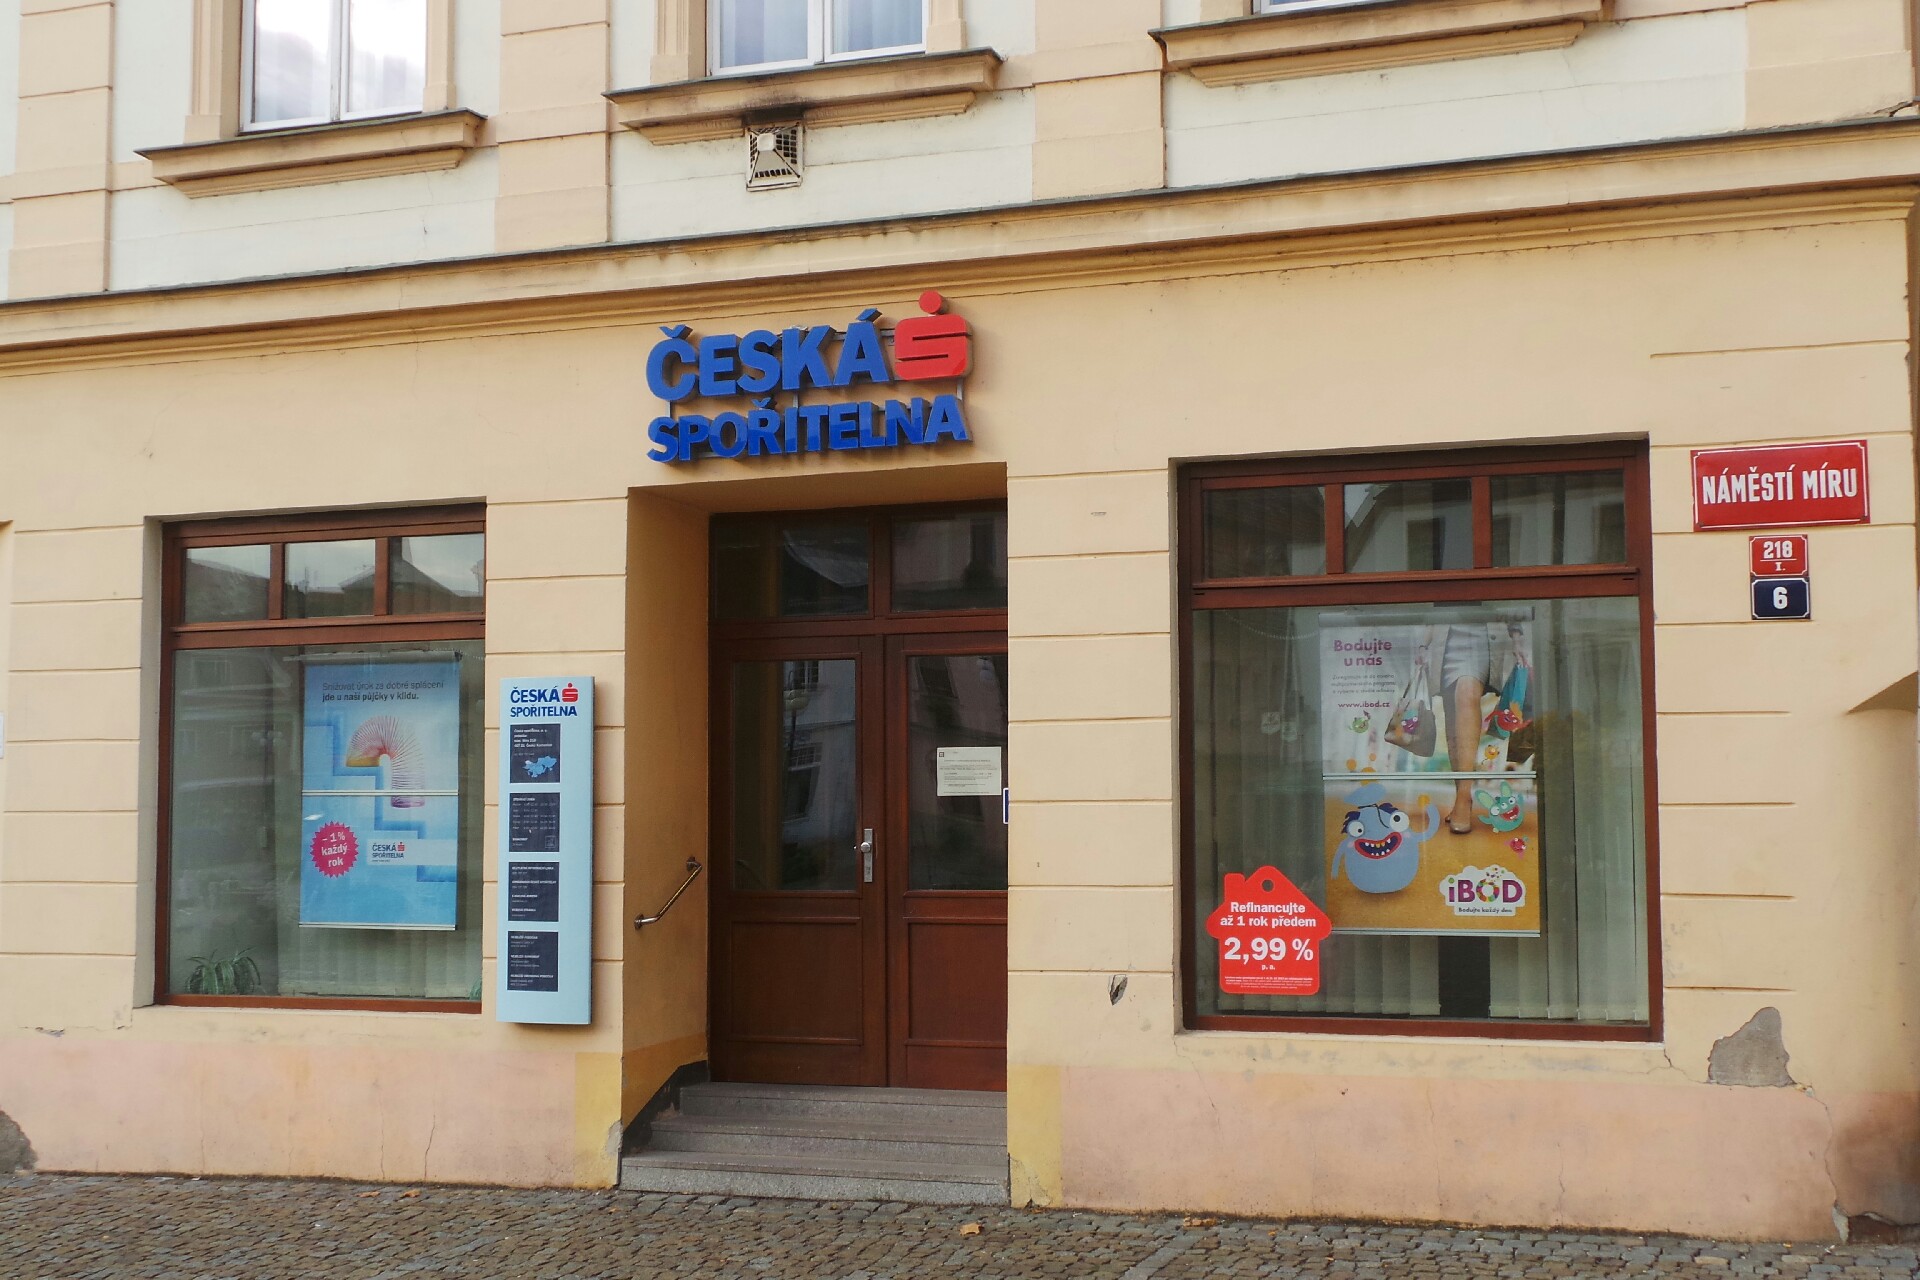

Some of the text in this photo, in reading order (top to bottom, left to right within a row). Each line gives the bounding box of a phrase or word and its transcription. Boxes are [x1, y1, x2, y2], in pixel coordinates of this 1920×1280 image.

[646, 308, 890, 401] ČESKÁ
[647, 394, 970, 463] SPOŘITELNA
[1702, 462, 1858, 505] NÁMĚSTÍ MÍRU
[1763, 540, 1793, 559] 218
[1772, 586, 1788, 609] 6
[1333, 638, 1393, 654] Bodujte
[1343, 653, 1383, 666] u nás
[386, 680, 409, 690] dobré
[410, 680, 444, 691] splácení
[322, 692, 335, 702] jde
[510, 685, 560, 704] ČESKÁ
[510, 705, 578, 717] SPOŘITELNA
[1337, 700, 1391, 708] www.ibod.cz
[321, 842, 348, 856] každý
[372, 842, 397, 852] ČESKÁ
[328, 857, 344, 868] rok
[1448, 877, 1523, 903] iBOD
[1230, 901, 1306, 915] Refinancujte
[1220, 915, 1316, 928] až 1 rok předem
[1224, 936, 1314, 965] 2,99 %
